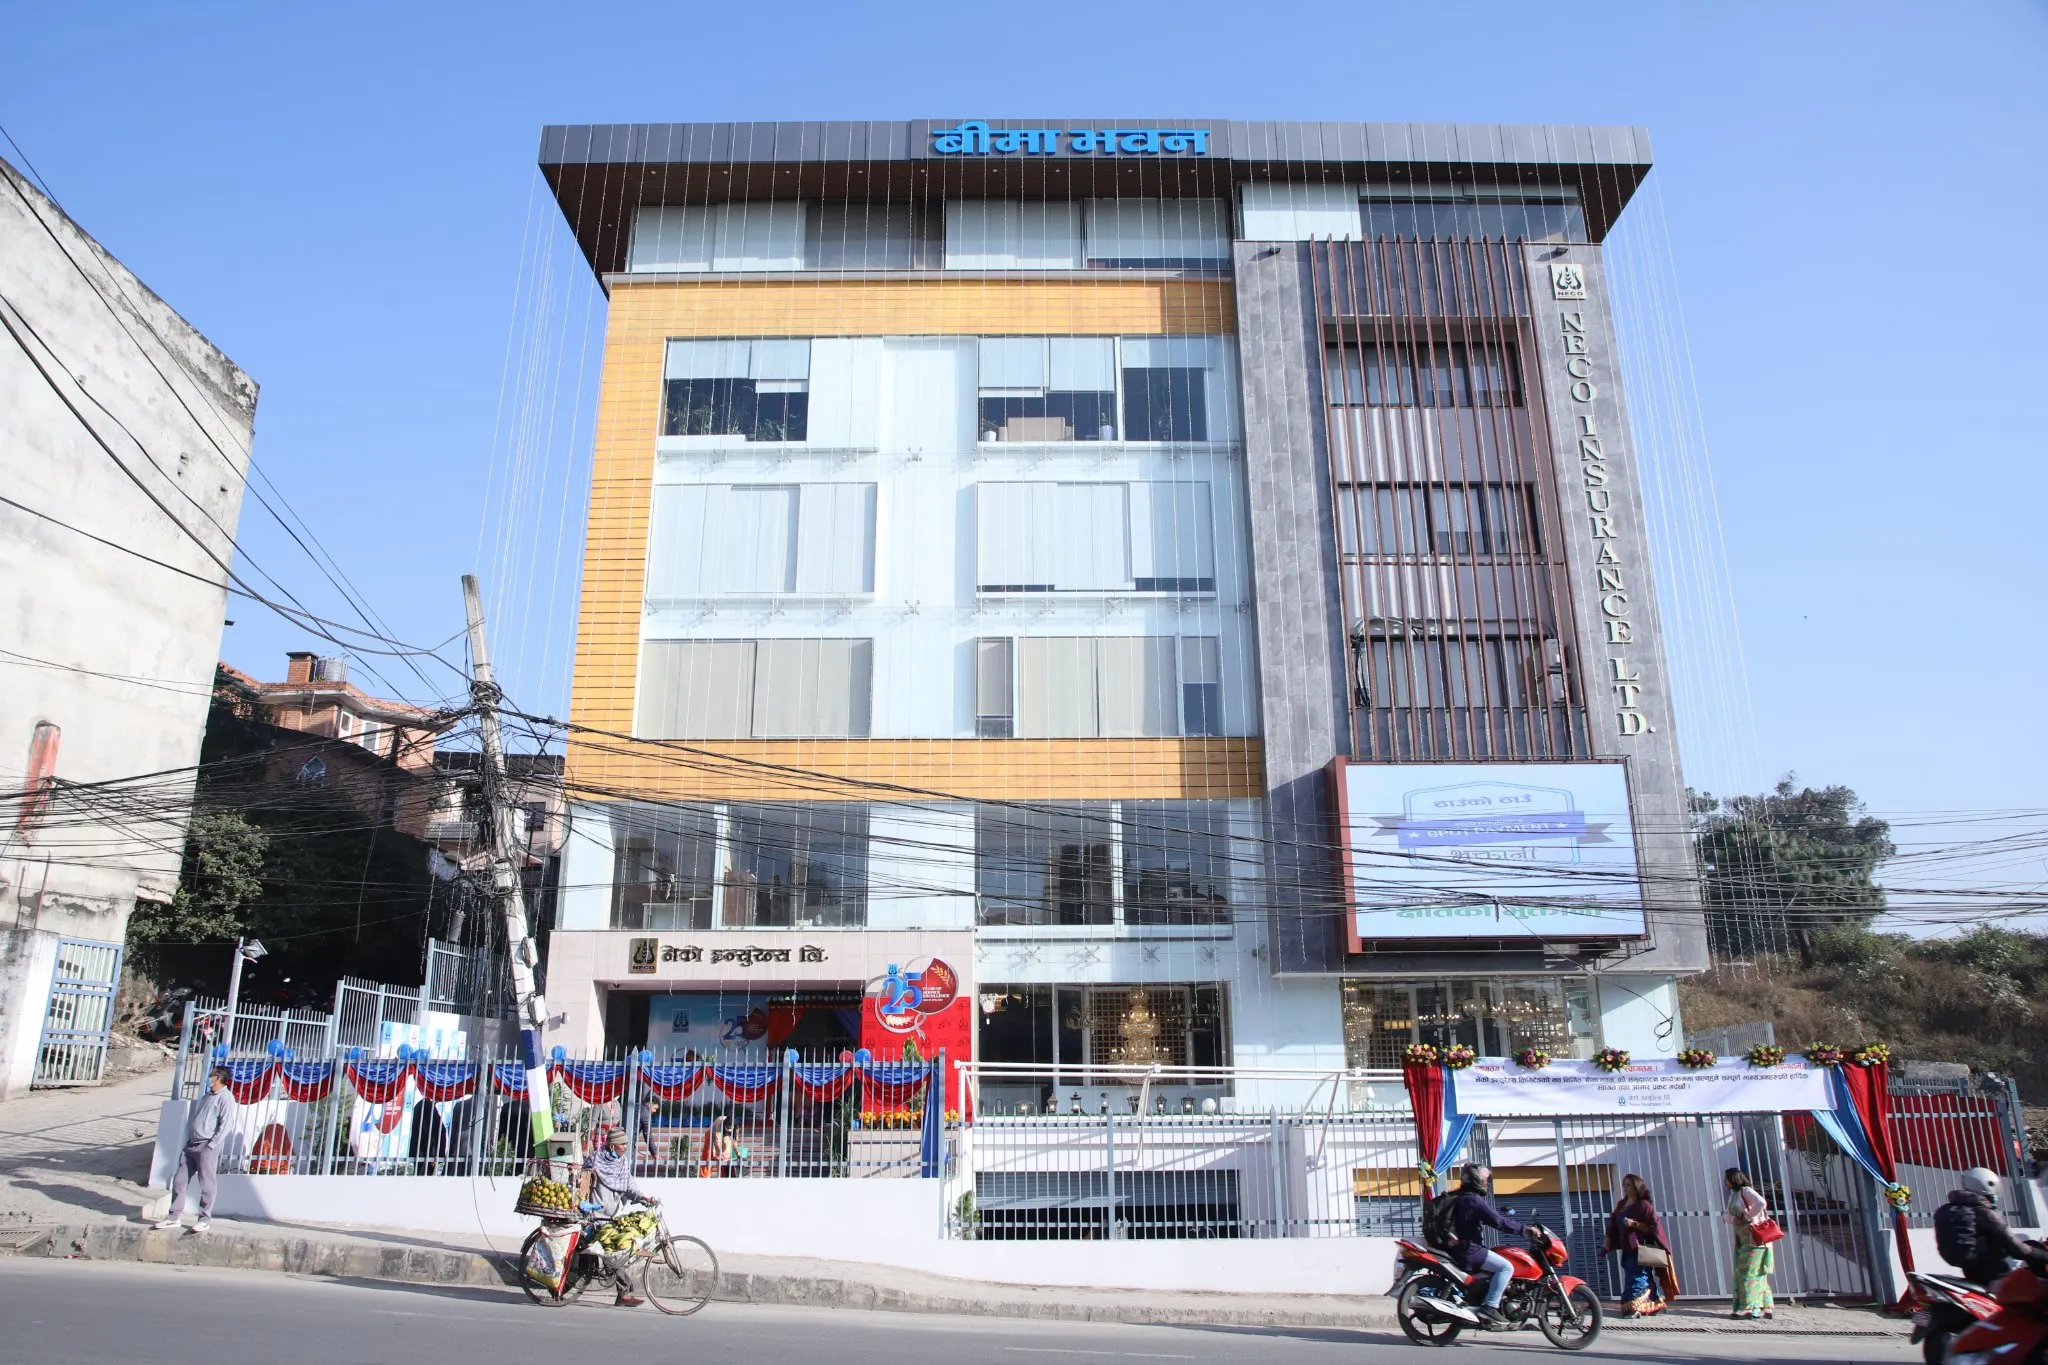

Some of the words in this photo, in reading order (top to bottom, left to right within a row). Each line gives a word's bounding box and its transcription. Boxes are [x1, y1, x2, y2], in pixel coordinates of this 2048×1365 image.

[933, 120, 1061, 154] बीमा
[1068, 128, 1211, 154] भवन
[1561, 312, 1597, 403] NECO
[1578, 414, 1634, 644] INSURANCE
[1610, 657, 1657, 736] LTD.
[1473, 822, 1551, 835] PAYMENT
[661, 944, 704, 963] नेको
[799, 944, 829, 963] लि.
[881, 972, 923, 1014] 25
